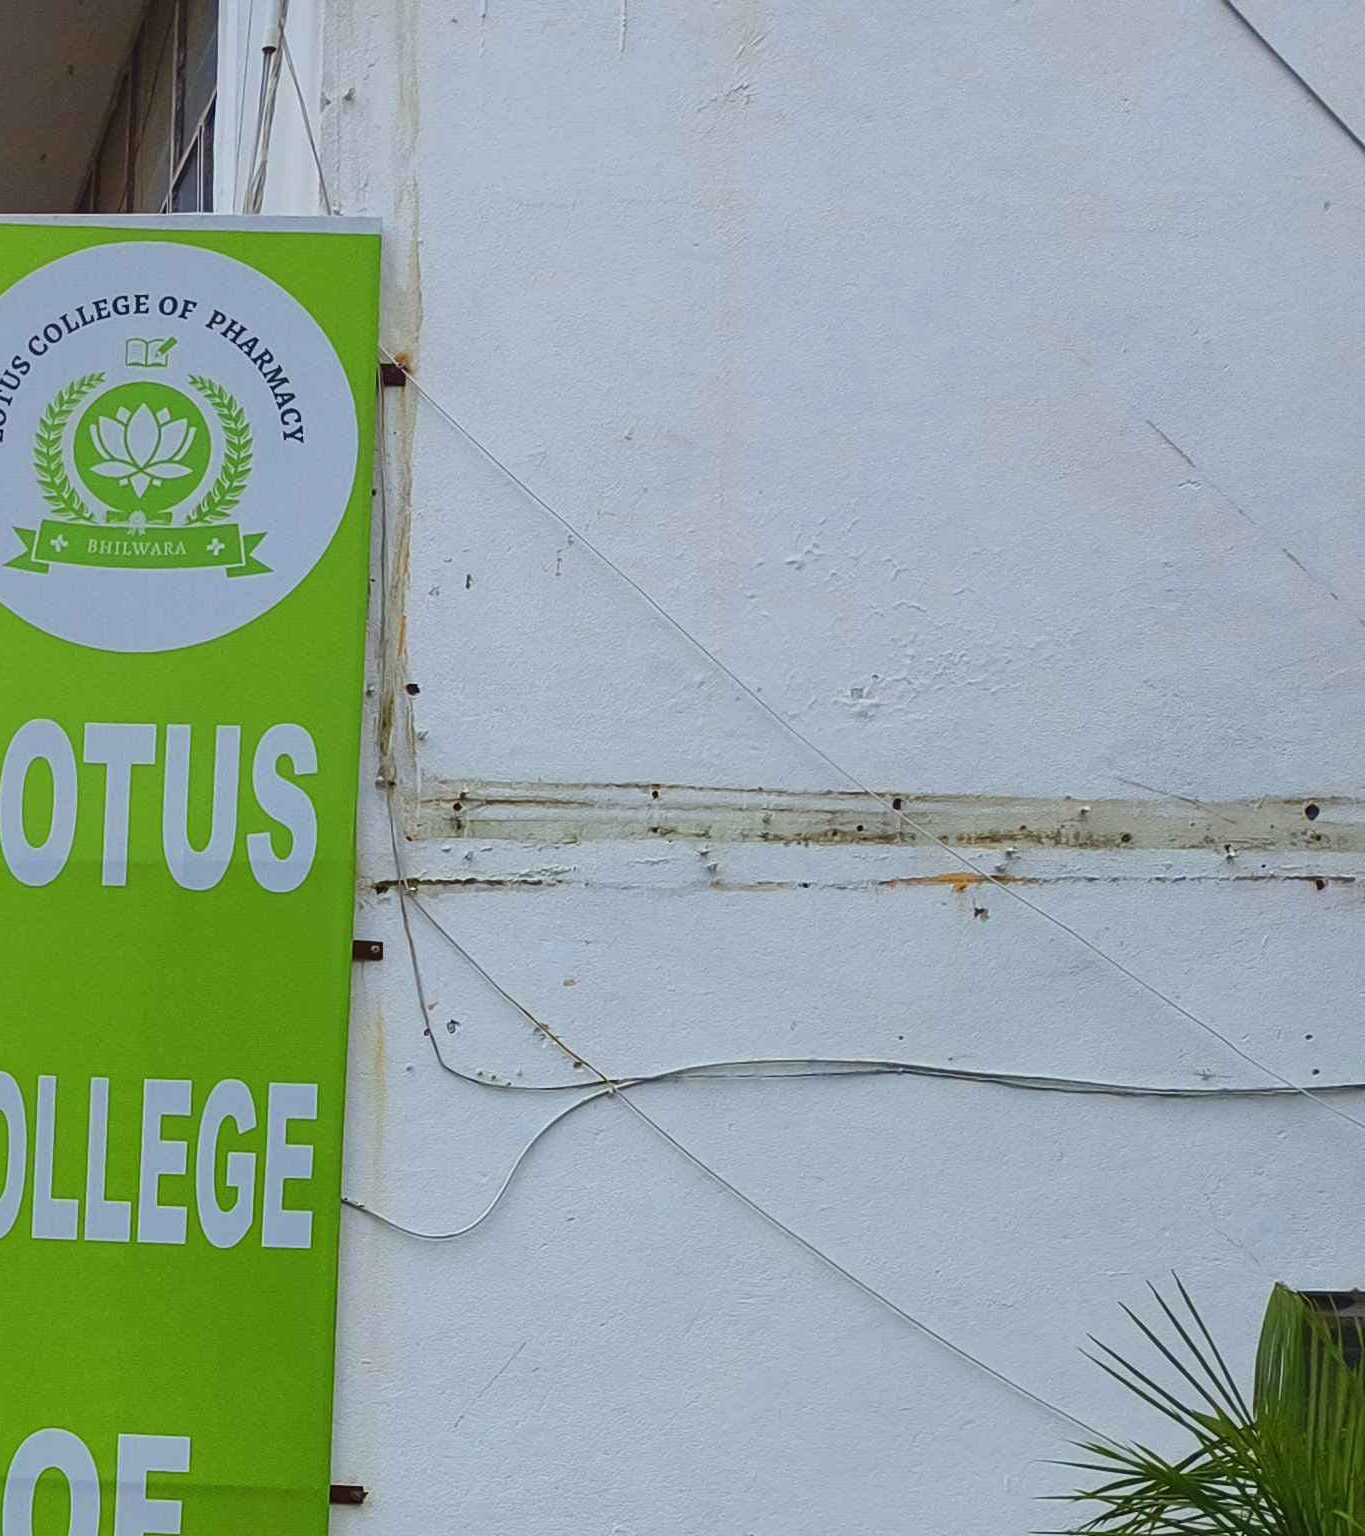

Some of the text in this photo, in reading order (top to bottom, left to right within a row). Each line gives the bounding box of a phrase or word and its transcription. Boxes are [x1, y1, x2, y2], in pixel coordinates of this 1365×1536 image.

[28, 294, 151, 357] COLLEGE
[158, 295, 198, 321] OF
[204, 309, 305, 444] PHARMACY
[86, 537, 188, 557] BHILWARA
